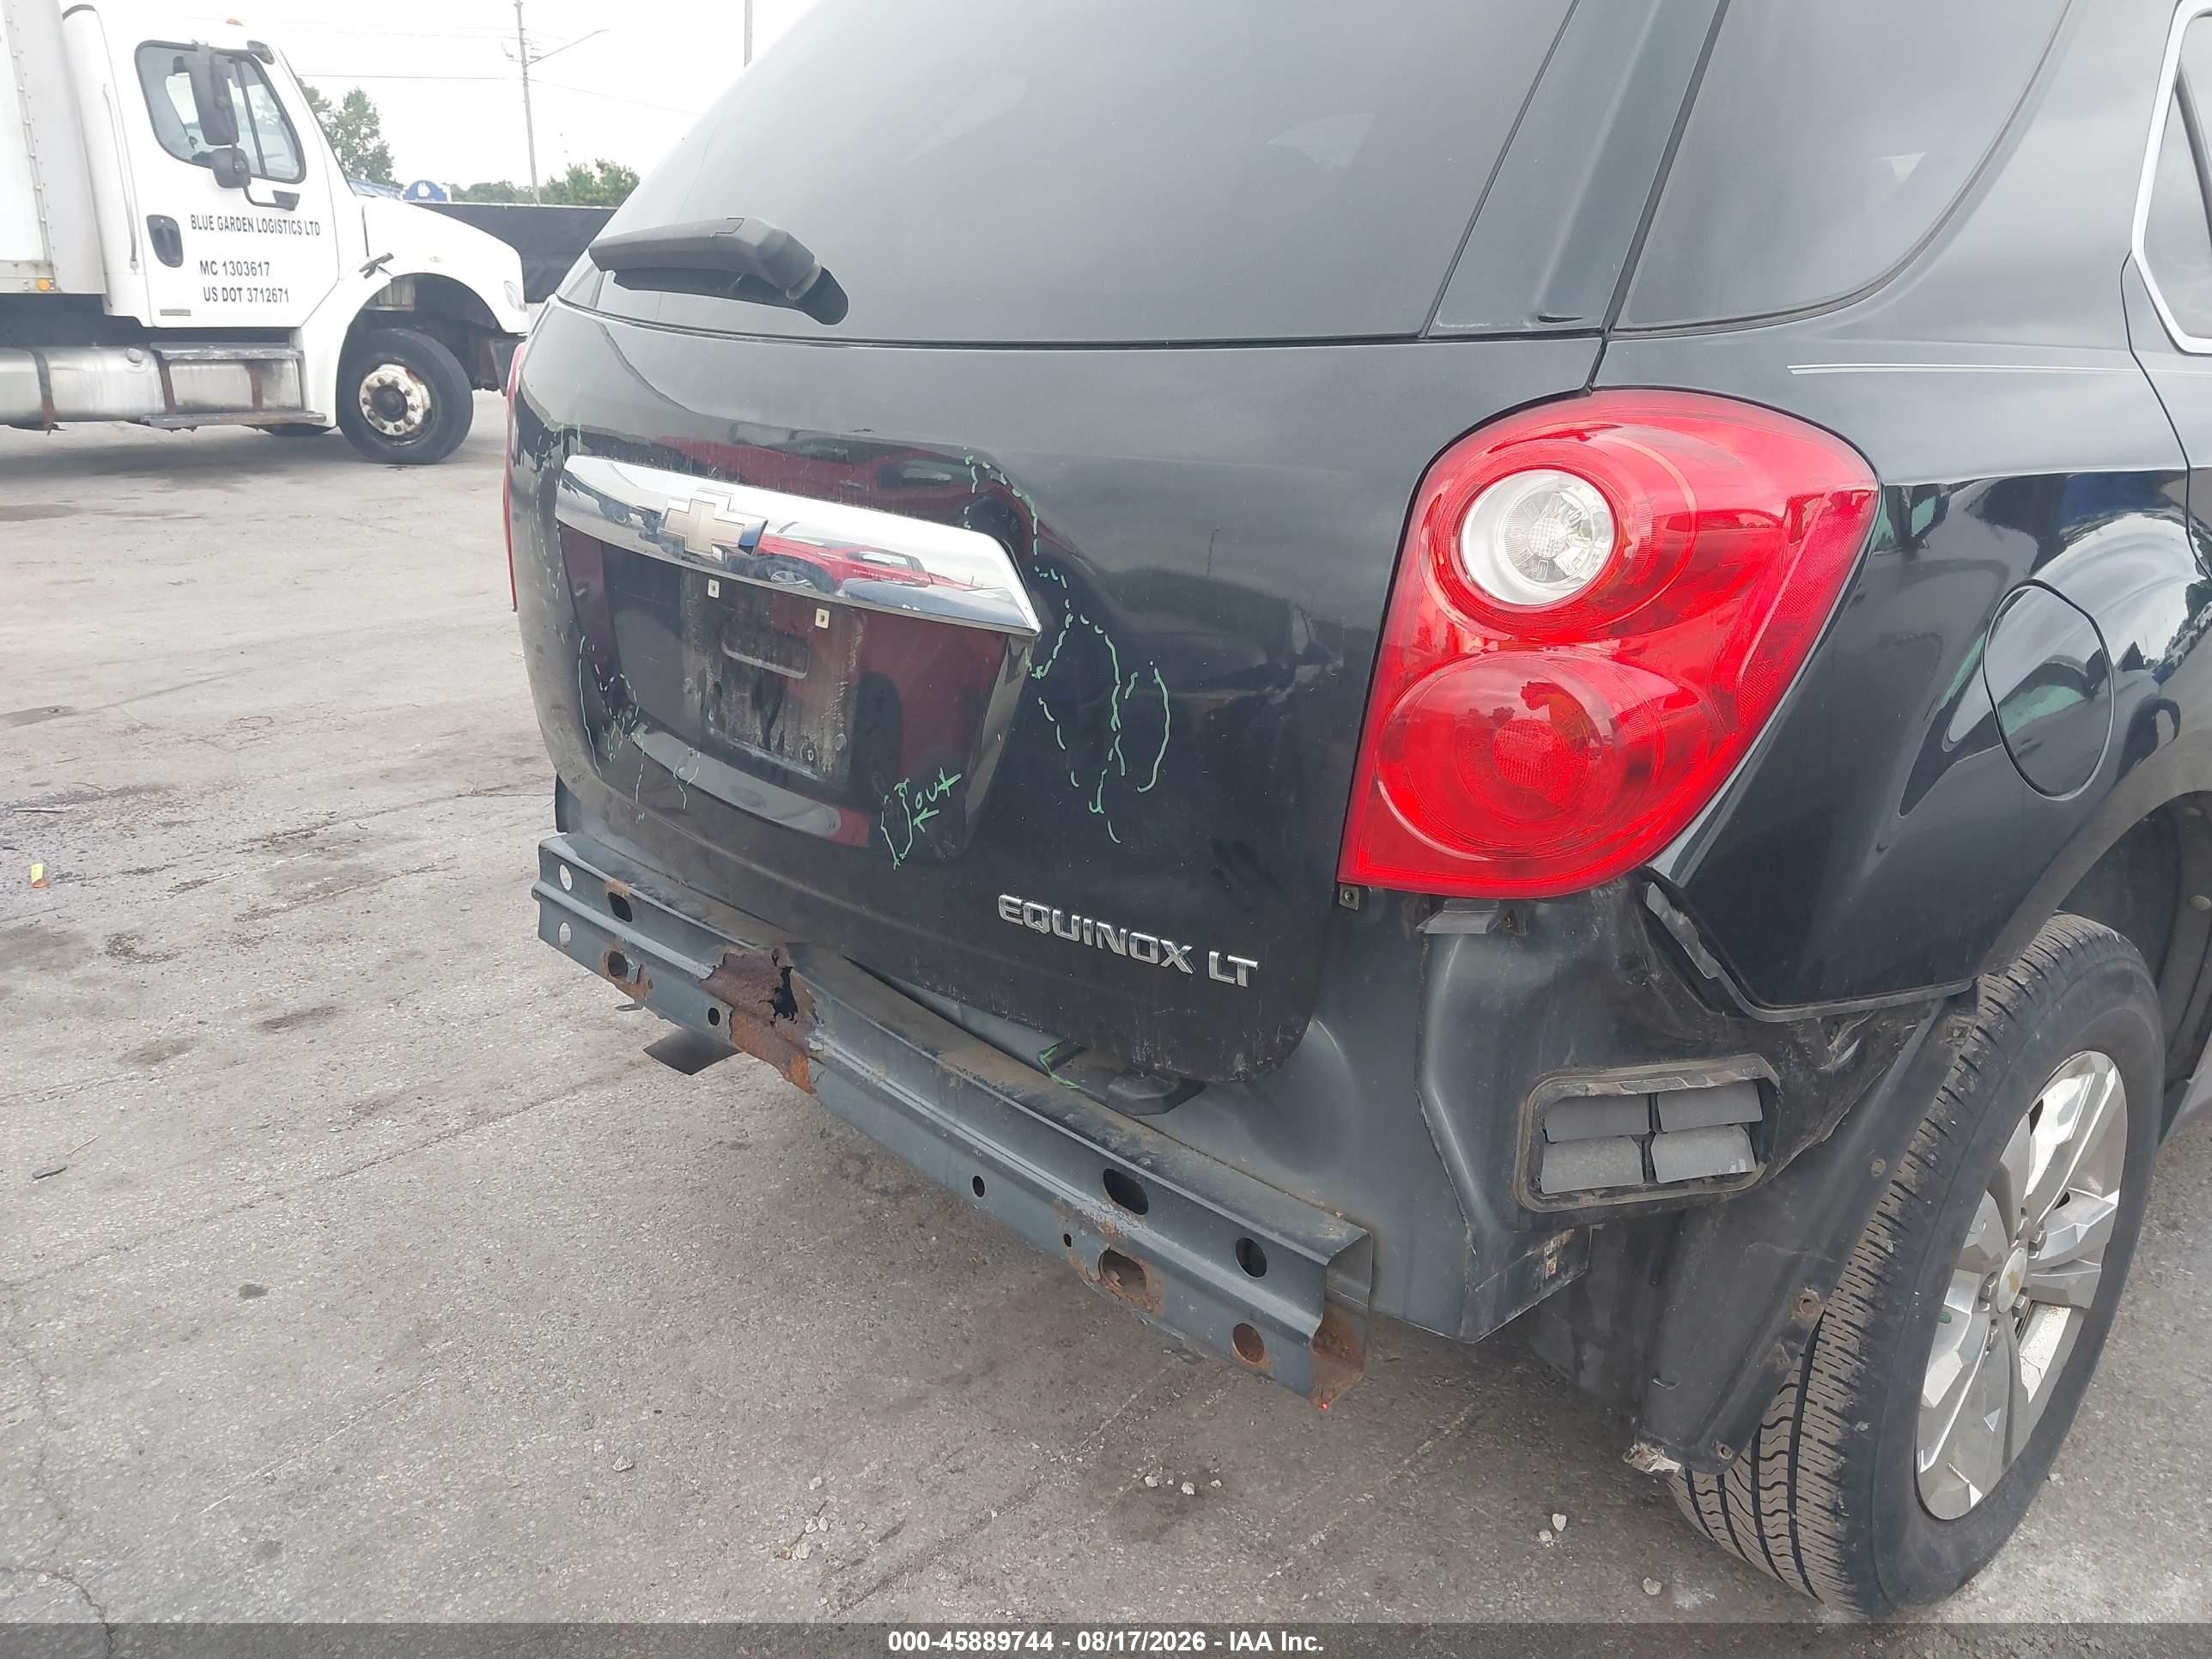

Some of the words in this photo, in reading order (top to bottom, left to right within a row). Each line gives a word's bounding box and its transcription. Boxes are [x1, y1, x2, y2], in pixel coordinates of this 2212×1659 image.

[191, 214, 216, 231] BLUE
[216, 216, 255, 233] GARDEN
[257, 217, 303, 236] LOGISTICS
[304, 220, 321, 237] LTD
[199, 260, 219, 276] MC
[222, 260, 270, 276] 1303617
[203, 286, 219, 302] US
[221, 287, 243, 302] DOT
[246, 287, 289, 303] 3712671
[998, 893, 1194, 975] EQUINOX
[1208, 950, 1259, 988] LT
